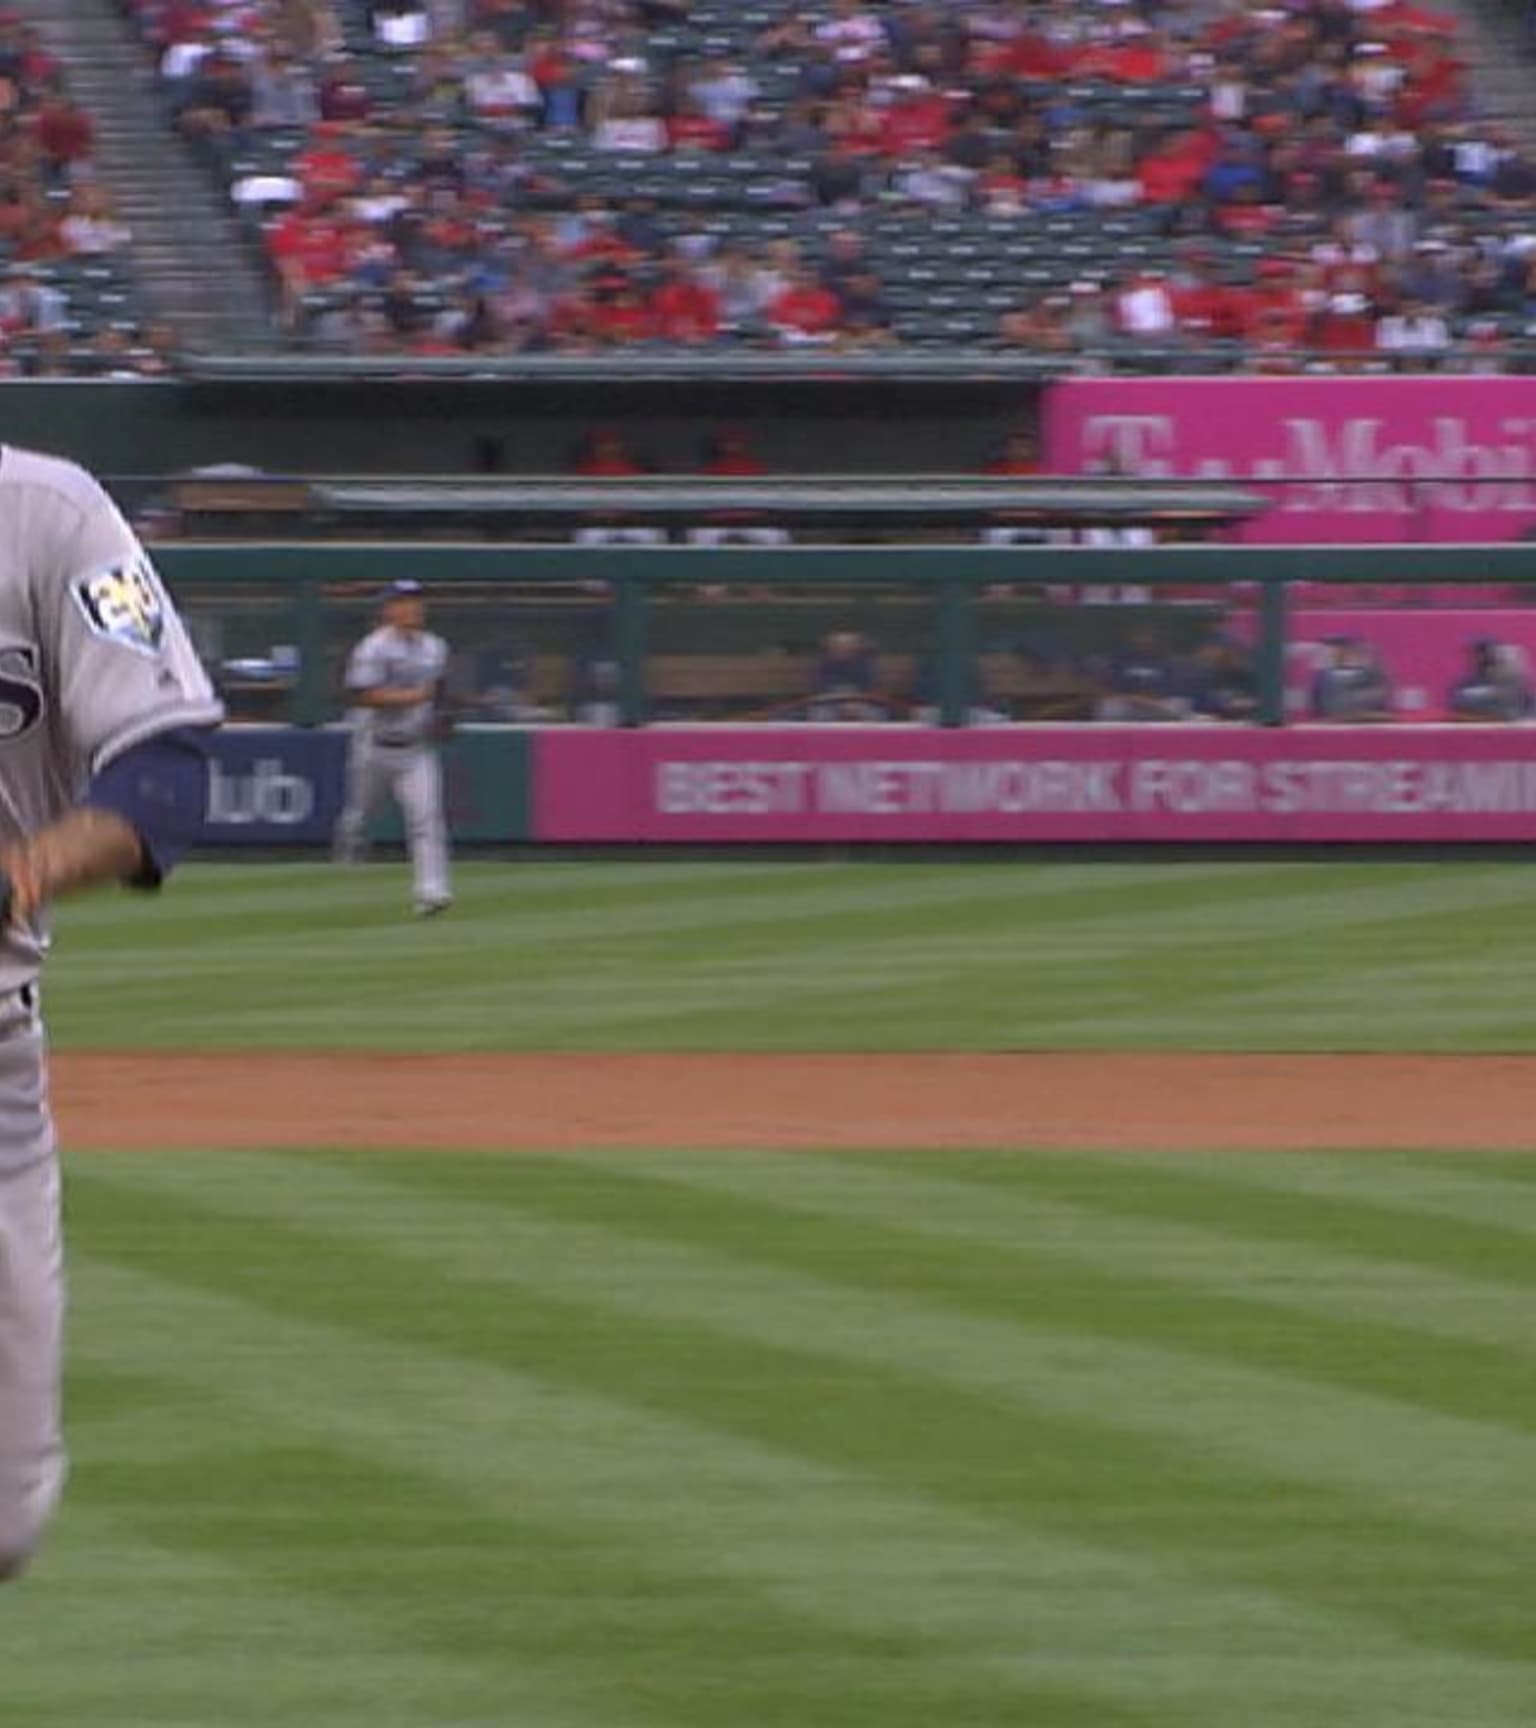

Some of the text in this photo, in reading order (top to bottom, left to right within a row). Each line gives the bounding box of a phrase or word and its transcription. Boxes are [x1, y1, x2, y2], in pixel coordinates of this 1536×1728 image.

[654, 760, 805, 813] BEST
[817, 760, 1122, 813] NETWORK
[1130, 760, 1257, 813] FOR
